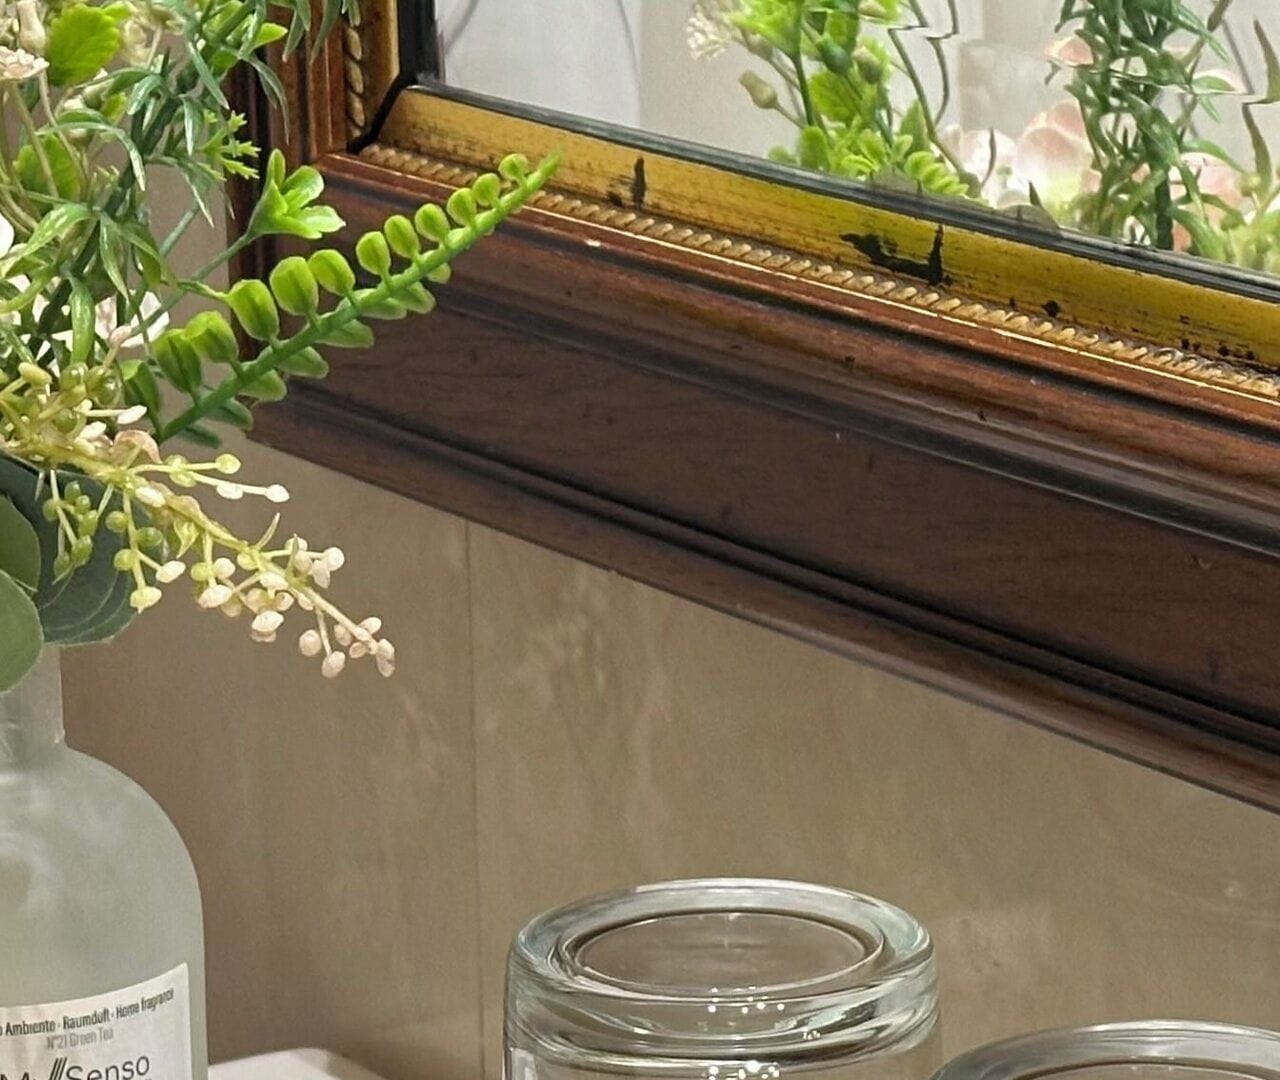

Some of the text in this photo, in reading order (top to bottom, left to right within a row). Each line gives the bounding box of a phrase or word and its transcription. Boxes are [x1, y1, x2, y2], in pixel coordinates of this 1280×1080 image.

[5, 1020, 56, 1037] Ambiente
[63, 1007, 111, 1030] Raumduft
[116, 1002, 140, 1020] Home
[141, 987, 175, 1012] fragrance
[69, 1031, 97, 1048] Green
[98, 1027, 114, 1043] Tea
